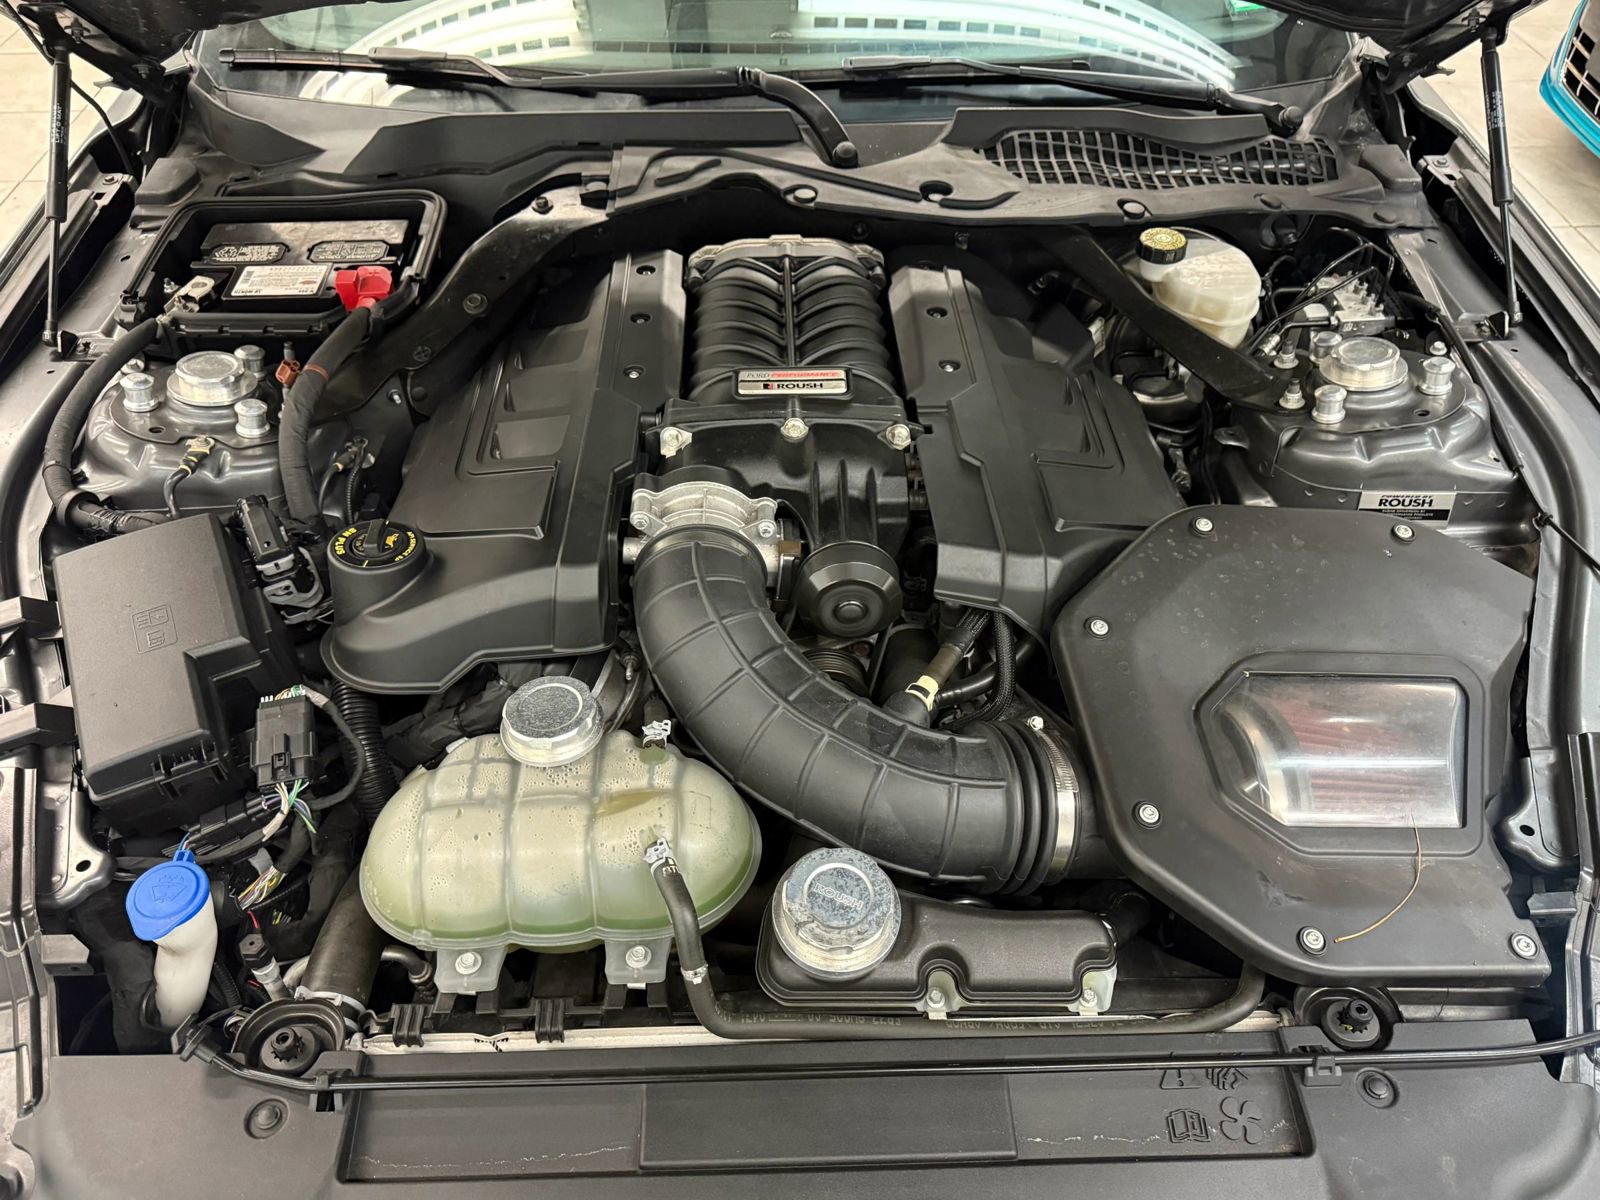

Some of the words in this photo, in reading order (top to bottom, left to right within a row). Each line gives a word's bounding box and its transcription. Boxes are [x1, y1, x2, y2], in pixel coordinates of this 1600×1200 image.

[1378, 498, 1434, 507] ROUSH
[334, 537, 346, 555] PLUS
[813, 882, 864, 911] ROUSH
